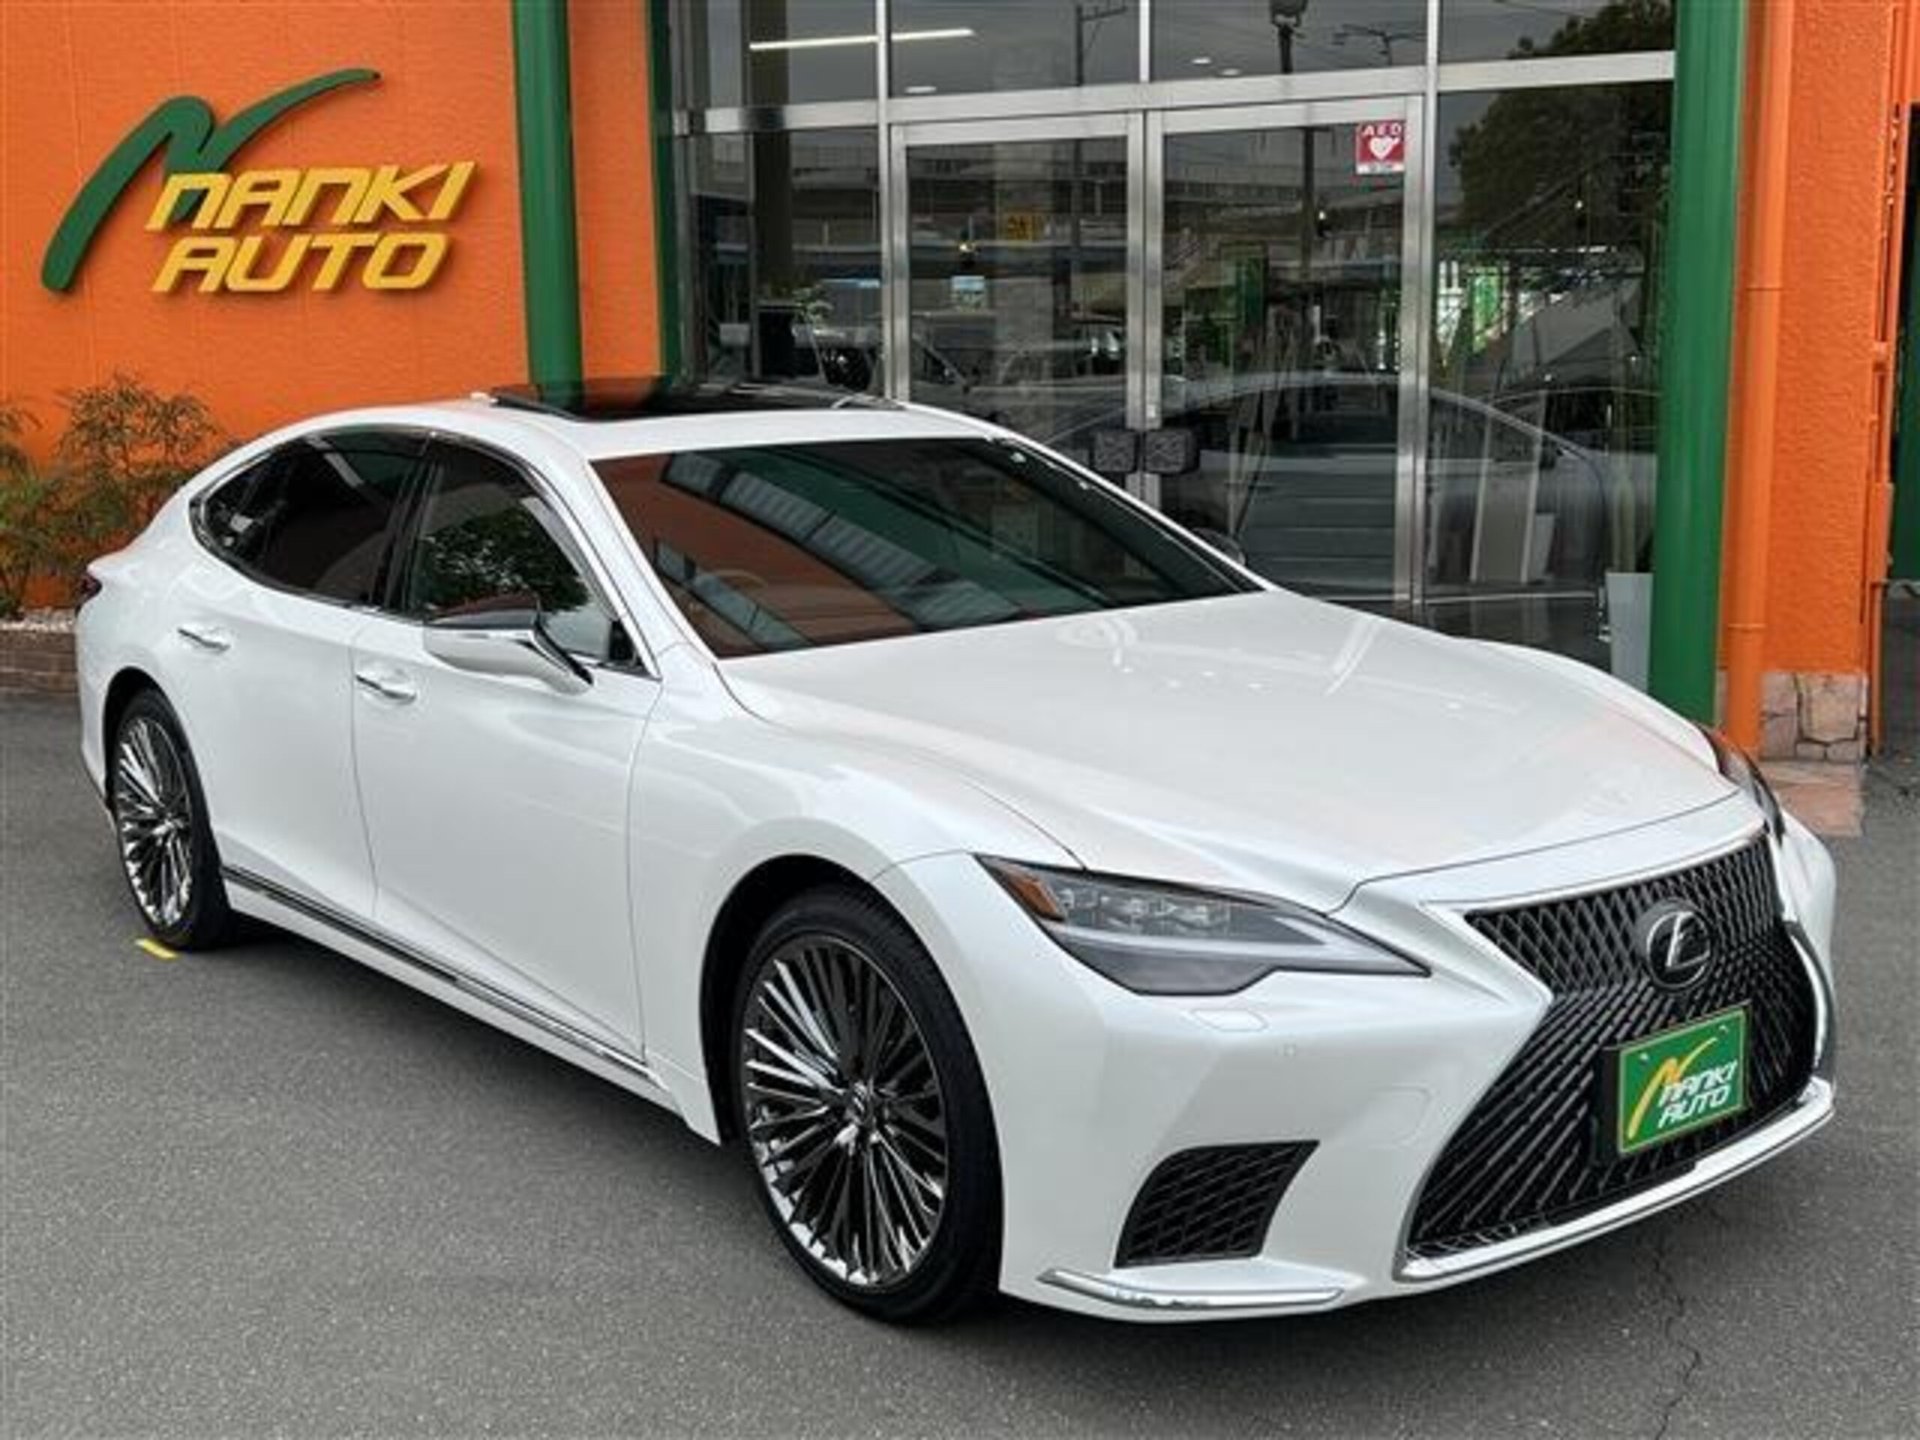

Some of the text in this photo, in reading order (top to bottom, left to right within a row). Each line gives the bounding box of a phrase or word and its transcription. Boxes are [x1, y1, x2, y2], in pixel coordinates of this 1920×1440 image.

[1362, 123, 1402, 137] AED
[145, 161, 477, 231] NANKI
[152, 233, 450, 293] AUTO
[1657, 1085, 1732, 1129] AUTO
[1658, 1060, 1738, 1107] NANKI
